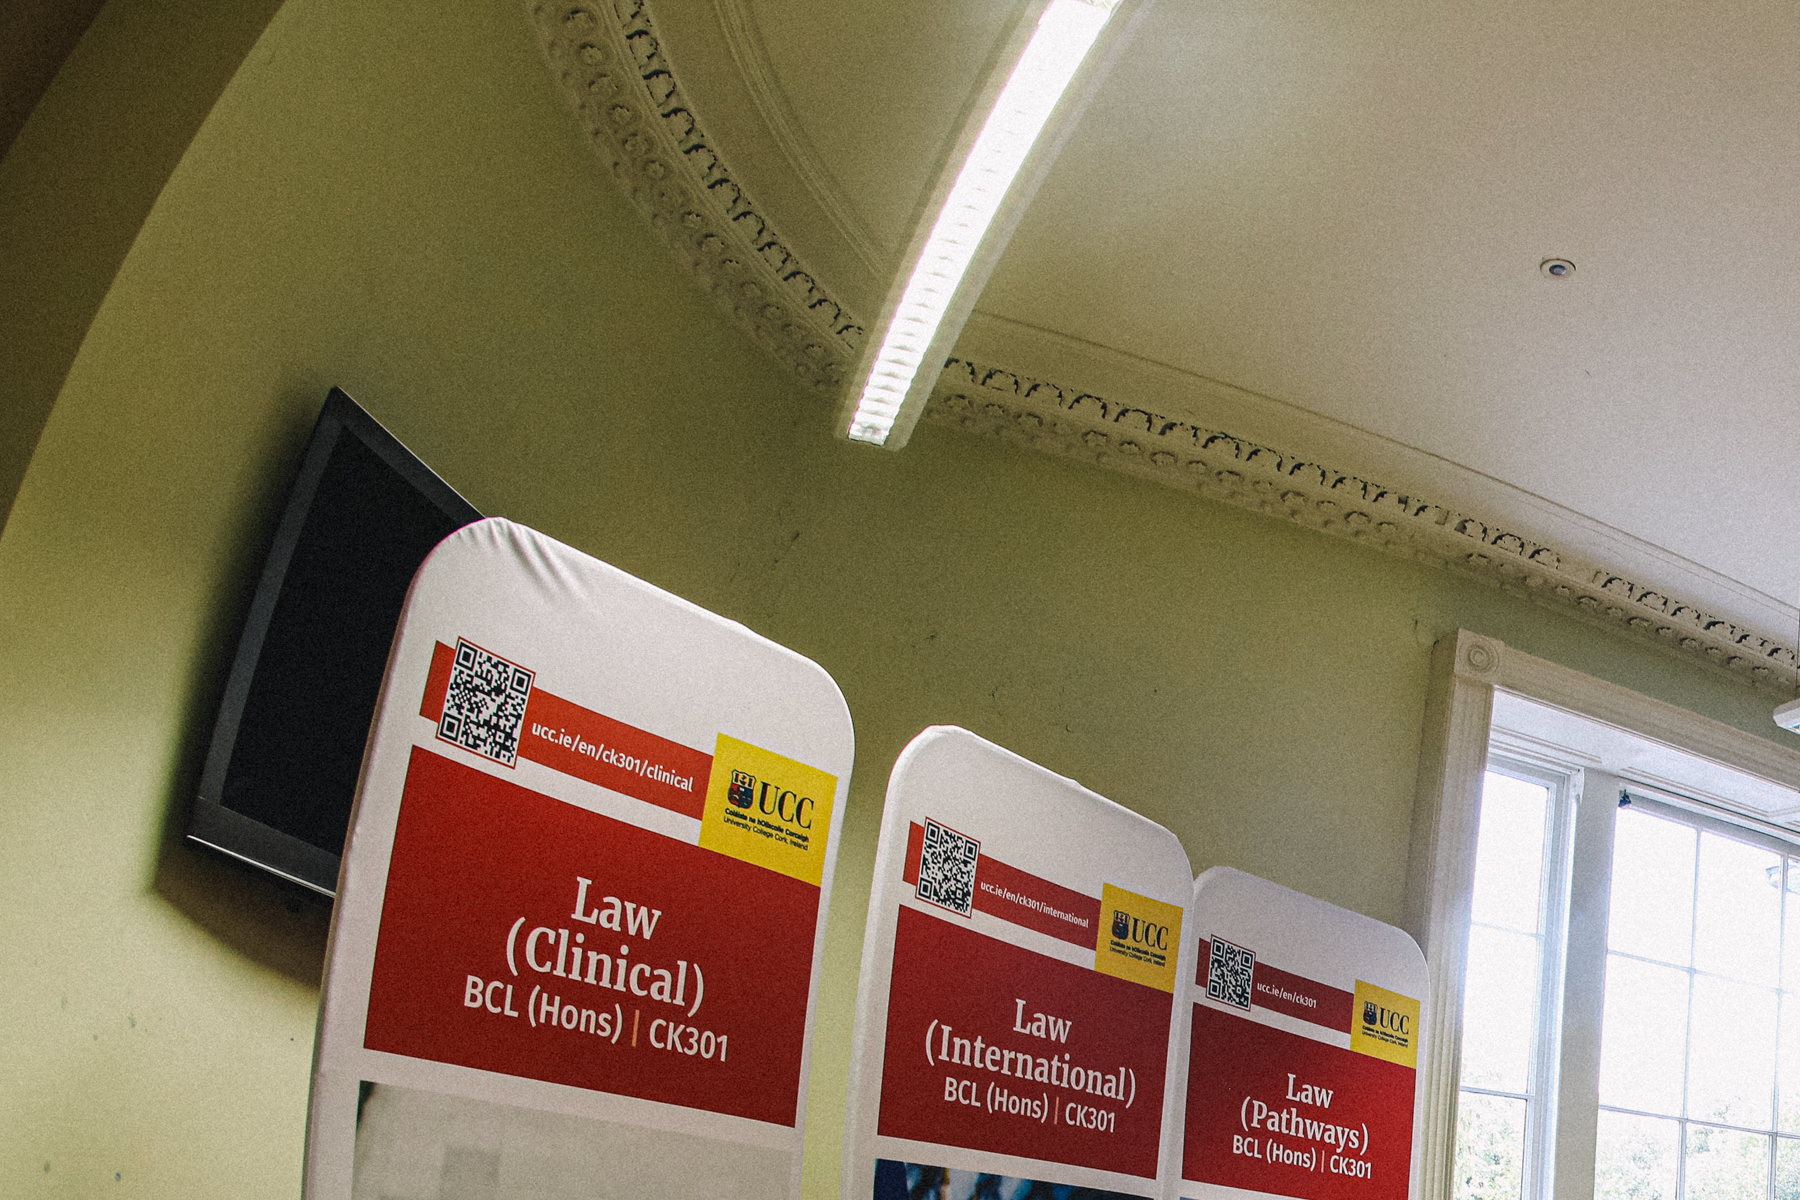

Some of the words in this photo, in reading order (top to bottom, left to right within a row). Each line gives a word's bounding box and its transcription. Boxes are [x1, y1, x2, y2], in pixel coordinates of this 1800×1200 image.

[531, 720, 694, 793] ucc.ie/en/ck301/clinical
[759, 780, 814, 830] UCC
[723, 816, 751, 832] University
[752, 826, 774, 838] College
[789, 840, 809, 851] Ireland
[571, 876, 662, 940] Law
[980, 879, 1089, 929] ucc.ie/en/ck301/international
[1132, 917, 1169, 951] UCC
[506, 916, 705, 1018] (Clinical)
[463, 975, 520, 1018] BCL
[528, 985, 624, 1045] (Hons)
[649, 1018, 730, 1062] CK301
[1256, 982, 1318, 1009] ucc.ie/en/ck301
[1380, 1006, 1410, 1035] UCC
[1013, 998, 1072, 1044] Law
[925, 1019, 1137, 1109] (International)
[944, 1077, 981, 1108] BCL
[986, 1081, 1049, 1124] (Hons)
[1065, 1102, 1116, 1133] CK301
[1285, 1073, 1334, 1109] Law
[1241, 1096, 1370, 1156] (Pathways)
[1232, 1134, 1262, 1160] BCL
[1266, 1138, 1317, 1172] (Hons)
[1329, 1154, 1372, 1179] CK301
